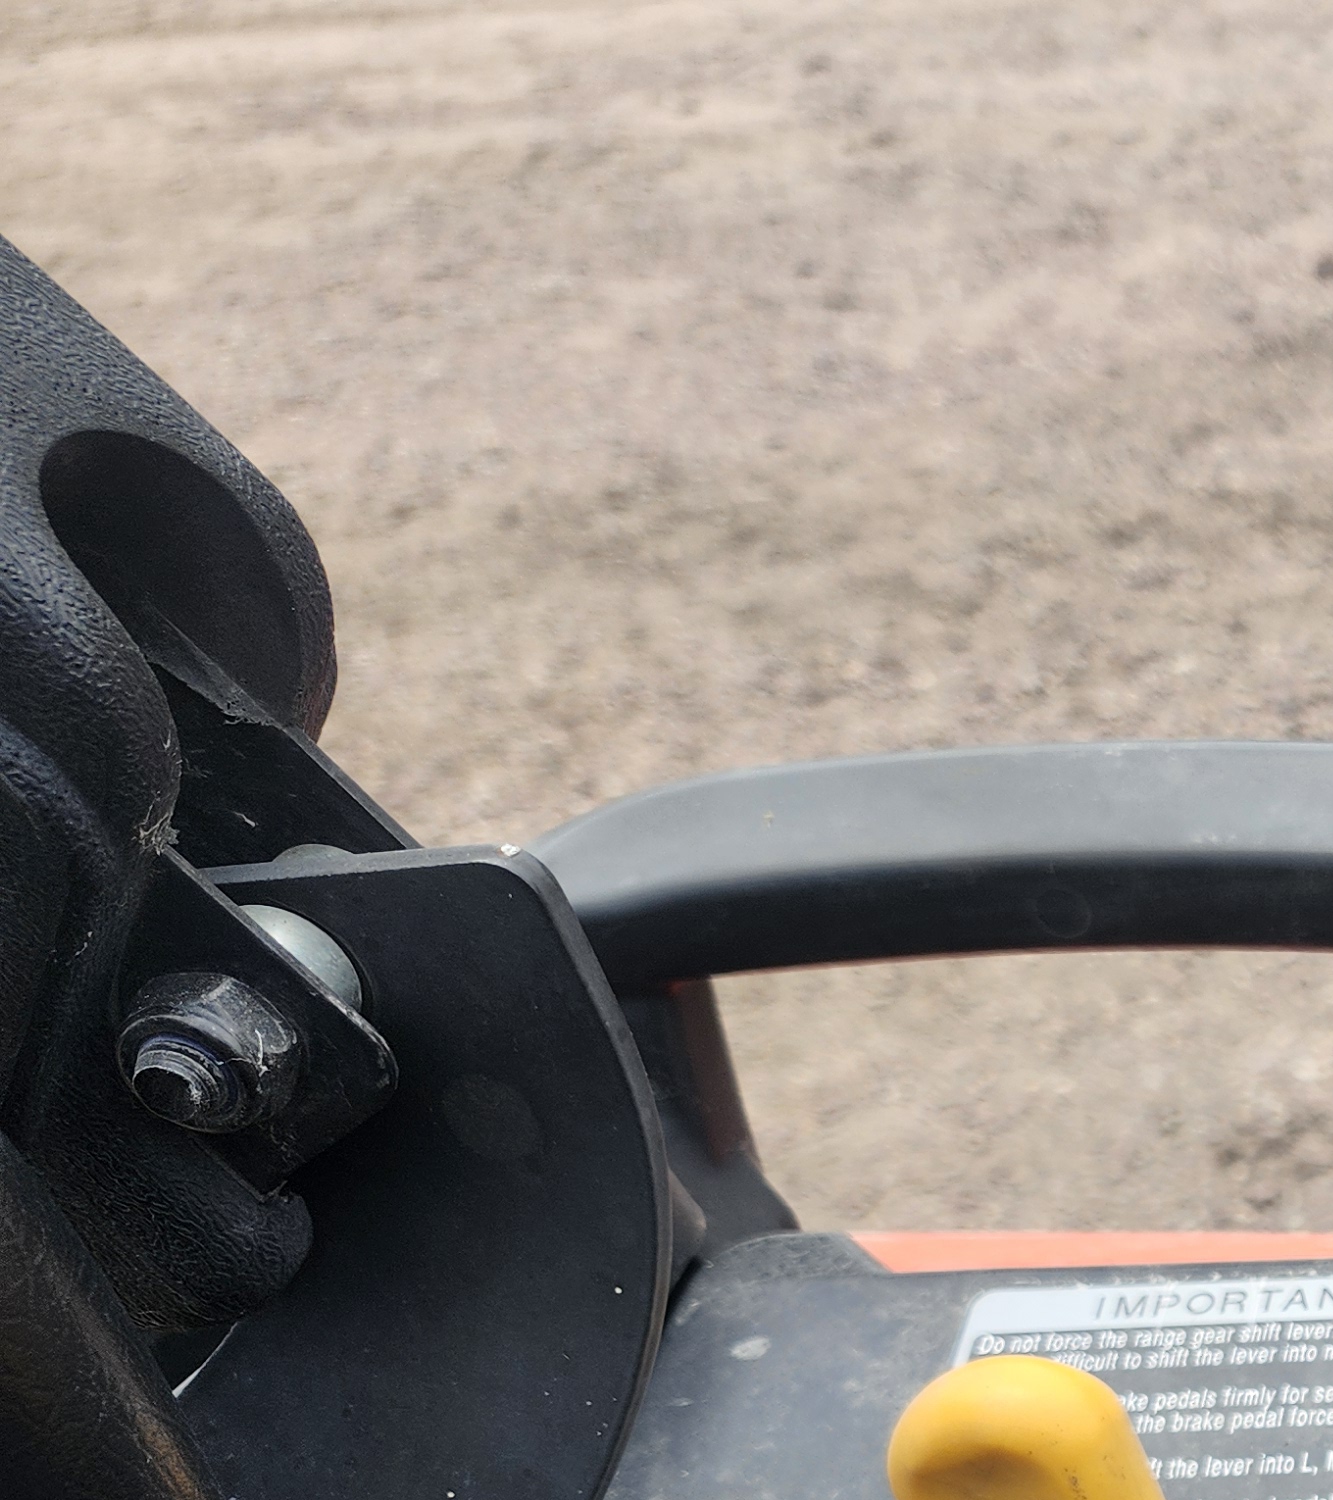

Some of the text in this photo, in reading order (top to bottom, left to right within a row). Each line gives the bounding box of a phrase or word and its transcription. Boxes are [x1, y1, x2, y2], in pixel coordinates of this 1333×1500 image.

[975, 1333, 1006, 1356] Do
[1009, 1334, 1042, 1353] not
[1045, 1331, 1093, 1351] force
[1098, 1328, 1128, 1349] the
[1133, 1326, 1186, 1350] range
[1191, 1325, 1235, 1348] gear
[1237, 1322, 1282, 1343] shift
[1123, 1349, 1142, 1370] to
[1146, 1347, 1188, 1369] shift
[1193, 1345, 1224, 1366] the
[1229, 1344, 1277, 1365] lever
[1282, 1341, 1317, 1362] into
[1150, 1386, 1218, 1415] pedals
[1222, 1383, 1277, 1412] firmly
[1281, 1382, 1310, 1404] for
[1134, 1412, 1166, 1434] the
[1168, 1409, 1225, 1433] brake
[1228, 1406, 1285, 1434] pedal
[1165, 1456, 1199, 1479] the
[1203, 1454, 1253, 1478] lever
[1258, 1452, 1295, 1475] into
[1300, 1451, 1319, 1476] L,
